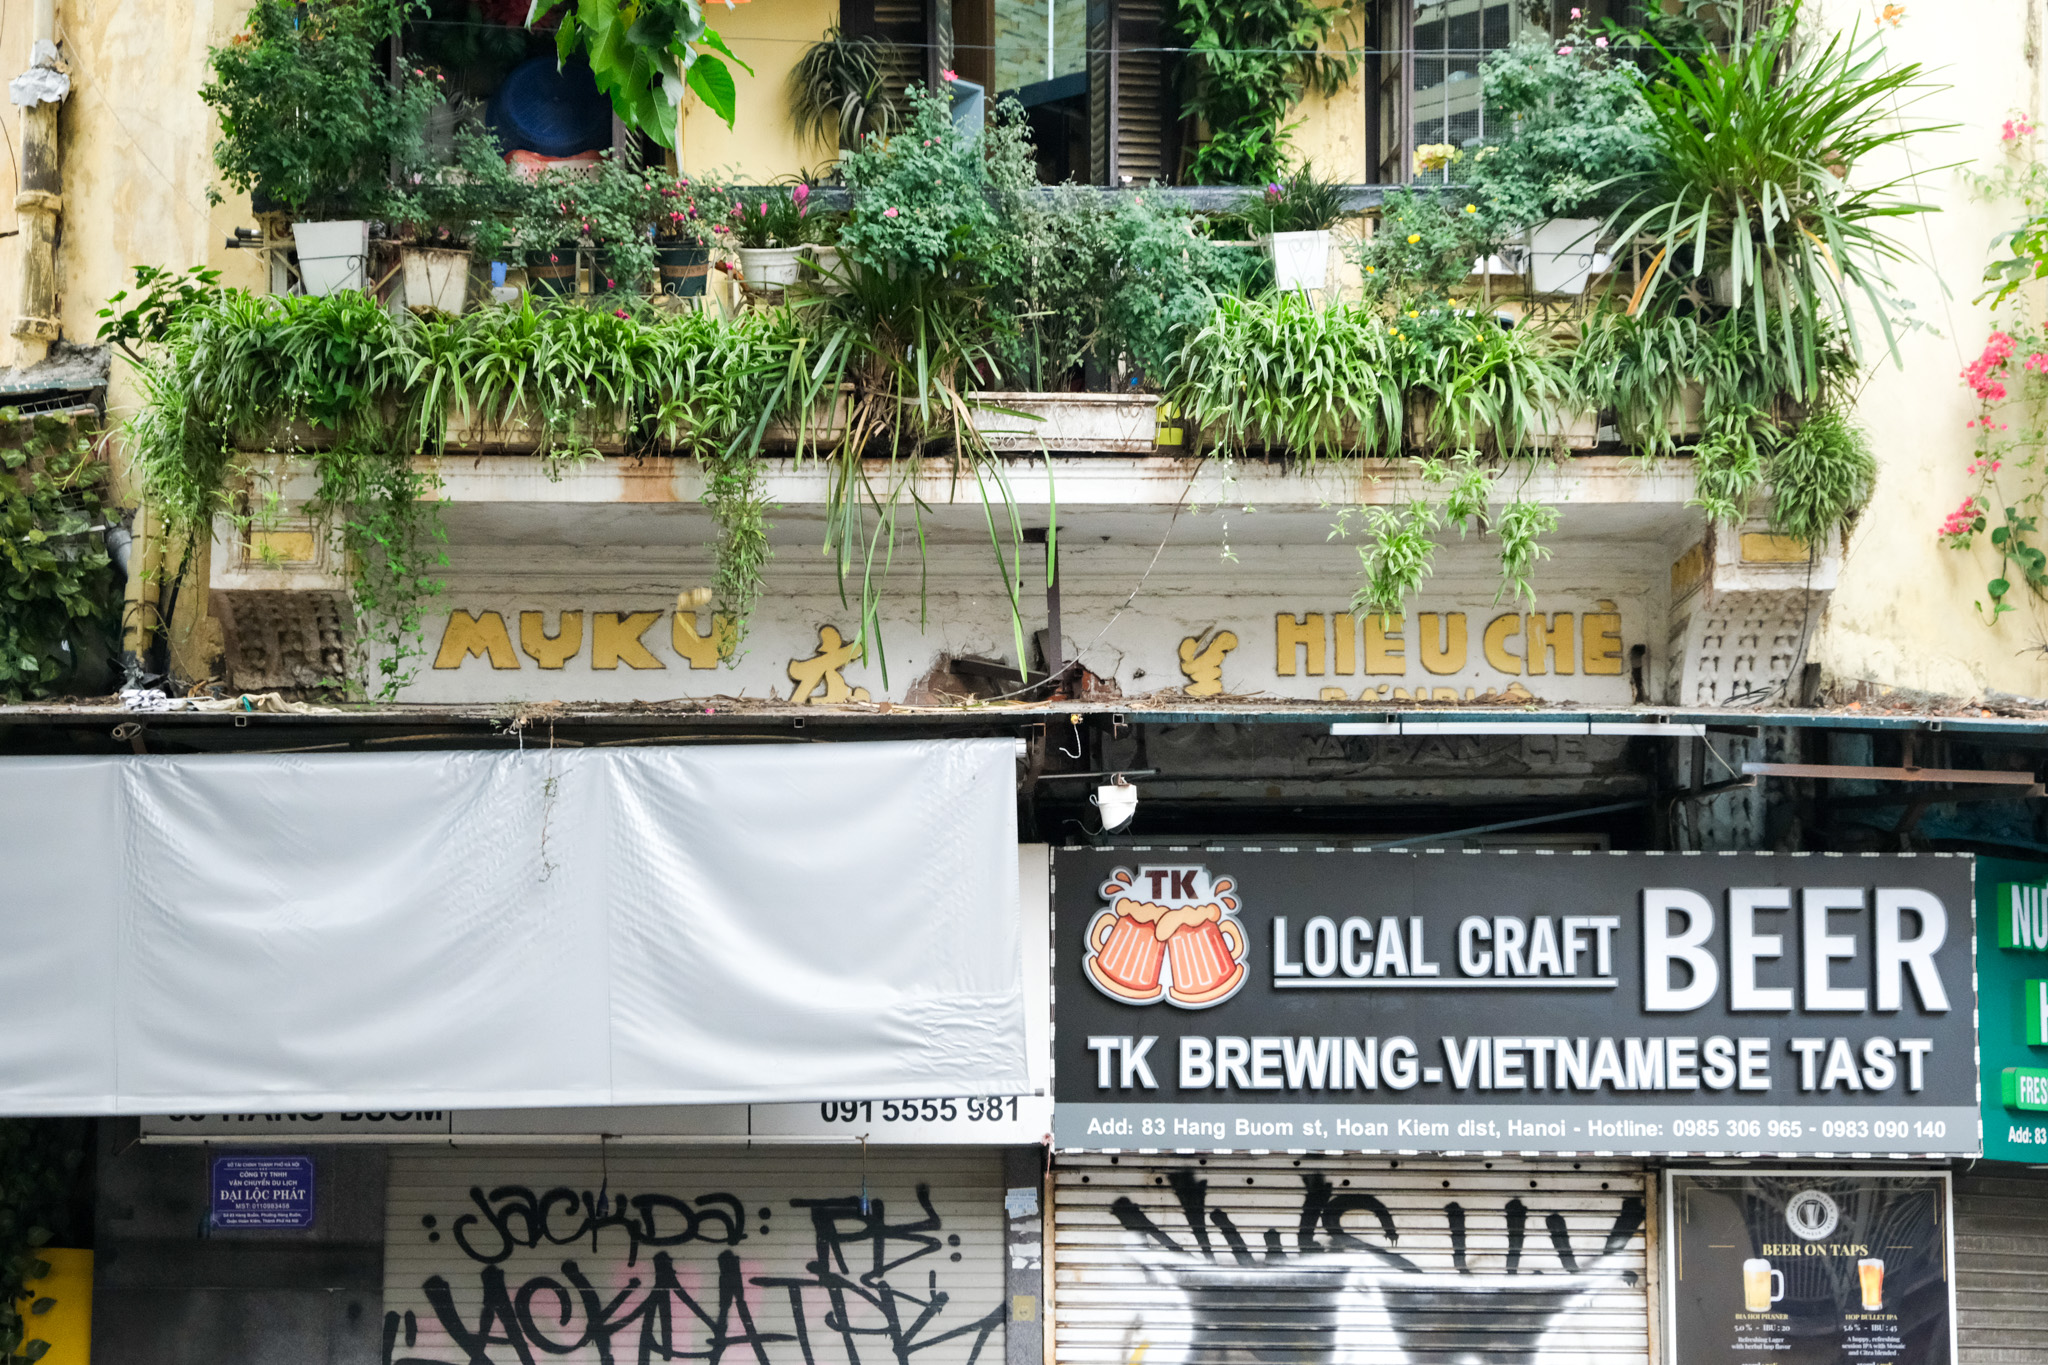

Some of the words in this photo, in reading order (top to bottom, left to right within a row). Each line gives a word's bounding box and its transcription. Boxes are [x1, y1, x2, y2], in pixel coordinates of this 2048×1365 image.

[1145, 870, 1199, 900] TK
[1273, 915, 1440, 977] LOCAL
[1458, 915, 1621, 977] CRAFT
[1643, 887, 1952, 1011] BEER
[1088, 1035, 1159, 1089] TK
[1792, 1036, 1934, 1090] TAST
[821, 1100, 872, 1123] 091
[882, 1098, 957, 1122] 5555
[967, 1096, 1018, 1122] 981
[1087, 1118, 1133, 1135] Add:
[1141, 1118, 1165, 1135] 83
[1173, 1118, 1226, 1140] Hang
[1235, 1119, 1293, 1136] Buom
[1303, 1119, 1328, 1139] st,
[1336, 1119, 1388, 1136] Hoan
[1398, 1119, 1449, 1137] Kiem
[1457, 1119, 1501, 1139] dist,
[1508, 1119, 1566, 1137] Hanoi
[1588, 1119, 1664, 1137] Hotline:
[1672, 1119, 1719, 1137] 0985
[1726, 1120, 1761, 1137] 306
[1767, 1120, 1802, 1138] 965
[1822, 1120, 1869, 1138] 0983
[1874, 1120, 1909, 1138] 090
[1913, 1121, 1946, 1138] 140
[2008, 1126, 2032, 1144] Add:
[2034, 1127, 2047, 1145] 83
[220, 1190, 242, 1203] ĐẠI
[245, 1187, 270, 1203] LỘC
[273, 1187, 306, 1200] PHÁT
[1762, 1243, 1801, 1256] BEER
[1804, 1243, 1827, 1256] ON
[1830, 1243, 1869, 1256] TAPS
